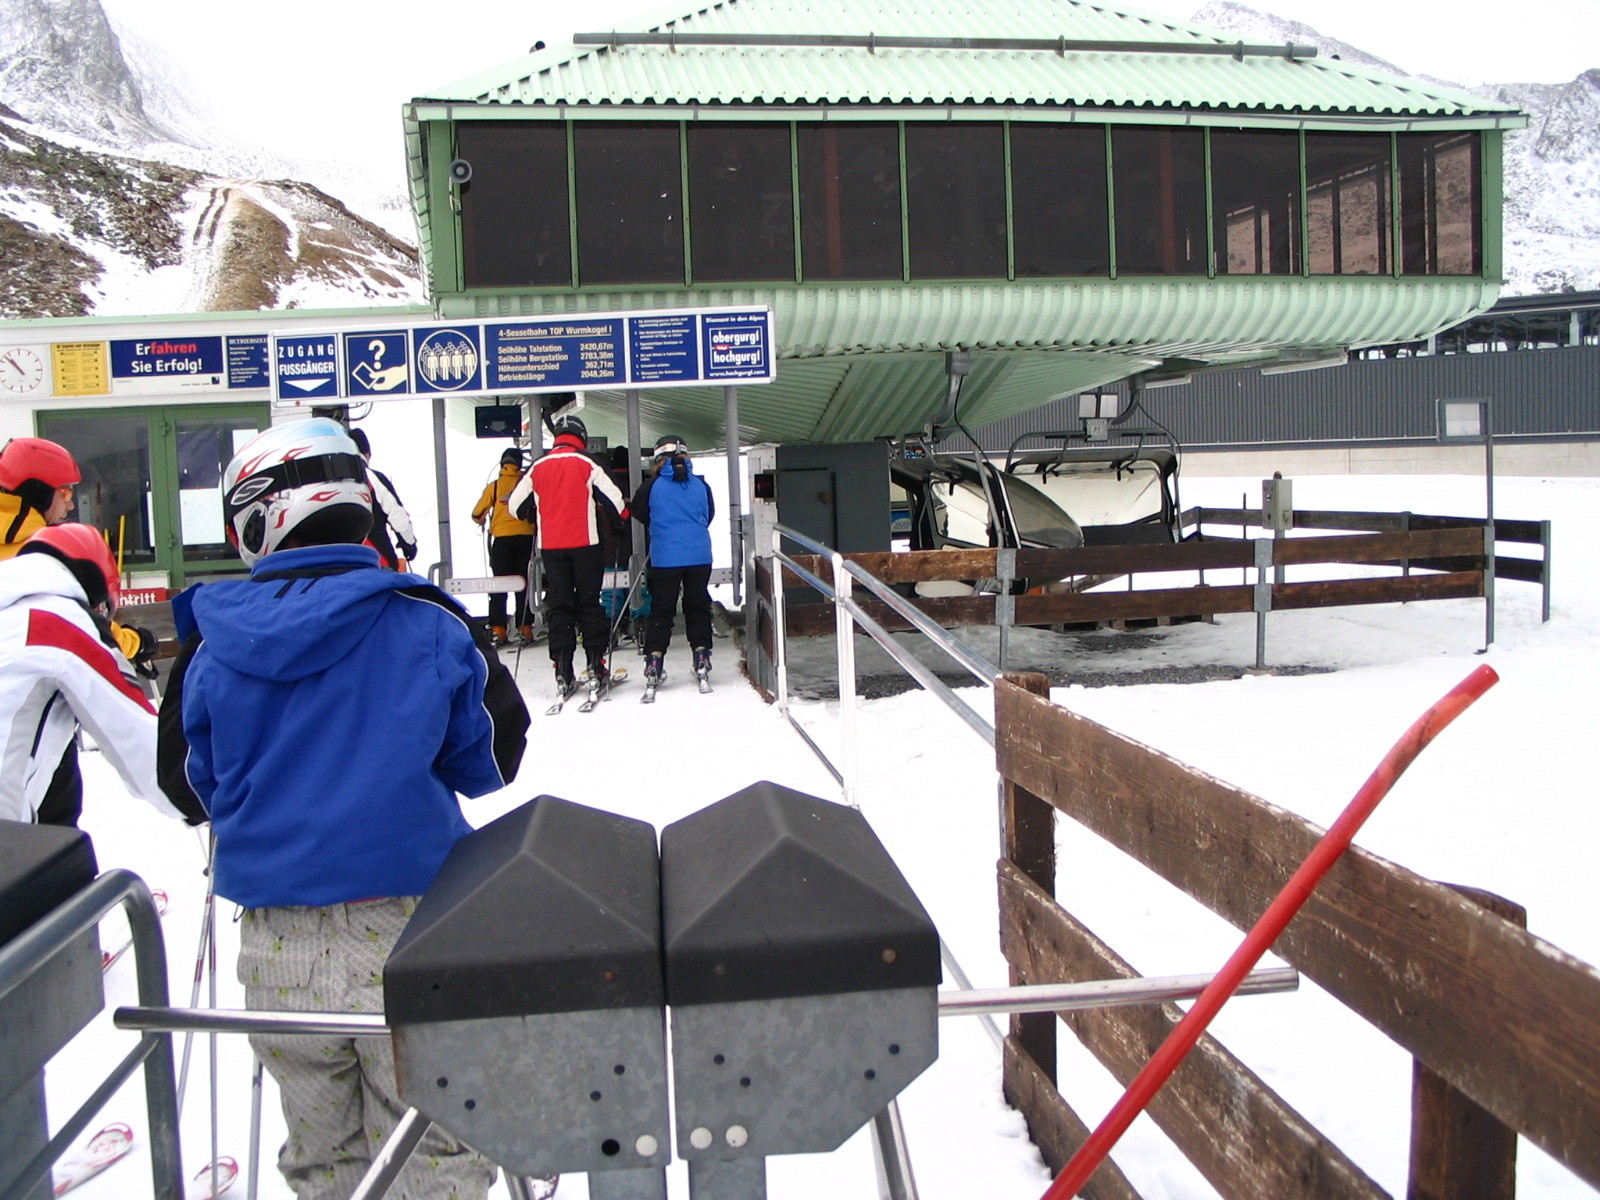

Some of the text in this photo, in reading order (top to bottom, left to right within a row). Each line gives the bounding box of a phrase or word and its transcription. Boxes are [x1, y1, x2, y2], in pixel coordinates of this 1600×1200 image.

[498, 328, 548, 337] 4-Sesselbahn
[549, 327, 563, 335] TOP
[566, 325, 607, 335] Wurmkogel
[712, 329, 760, 346] obergurgl
[135, 341, 197, 356] Erfahren
[278, 343, 335, 359] ZUGANG
[529, 345, 562, 353] Talstation
[529, 353, 568, 363] Bergstation
[713, 349, 760, 366] hochgurgl
[131, 358, 203, 374] Sie Erfolg!
[279, 360, 335, 376] FUSSGÄNGER
